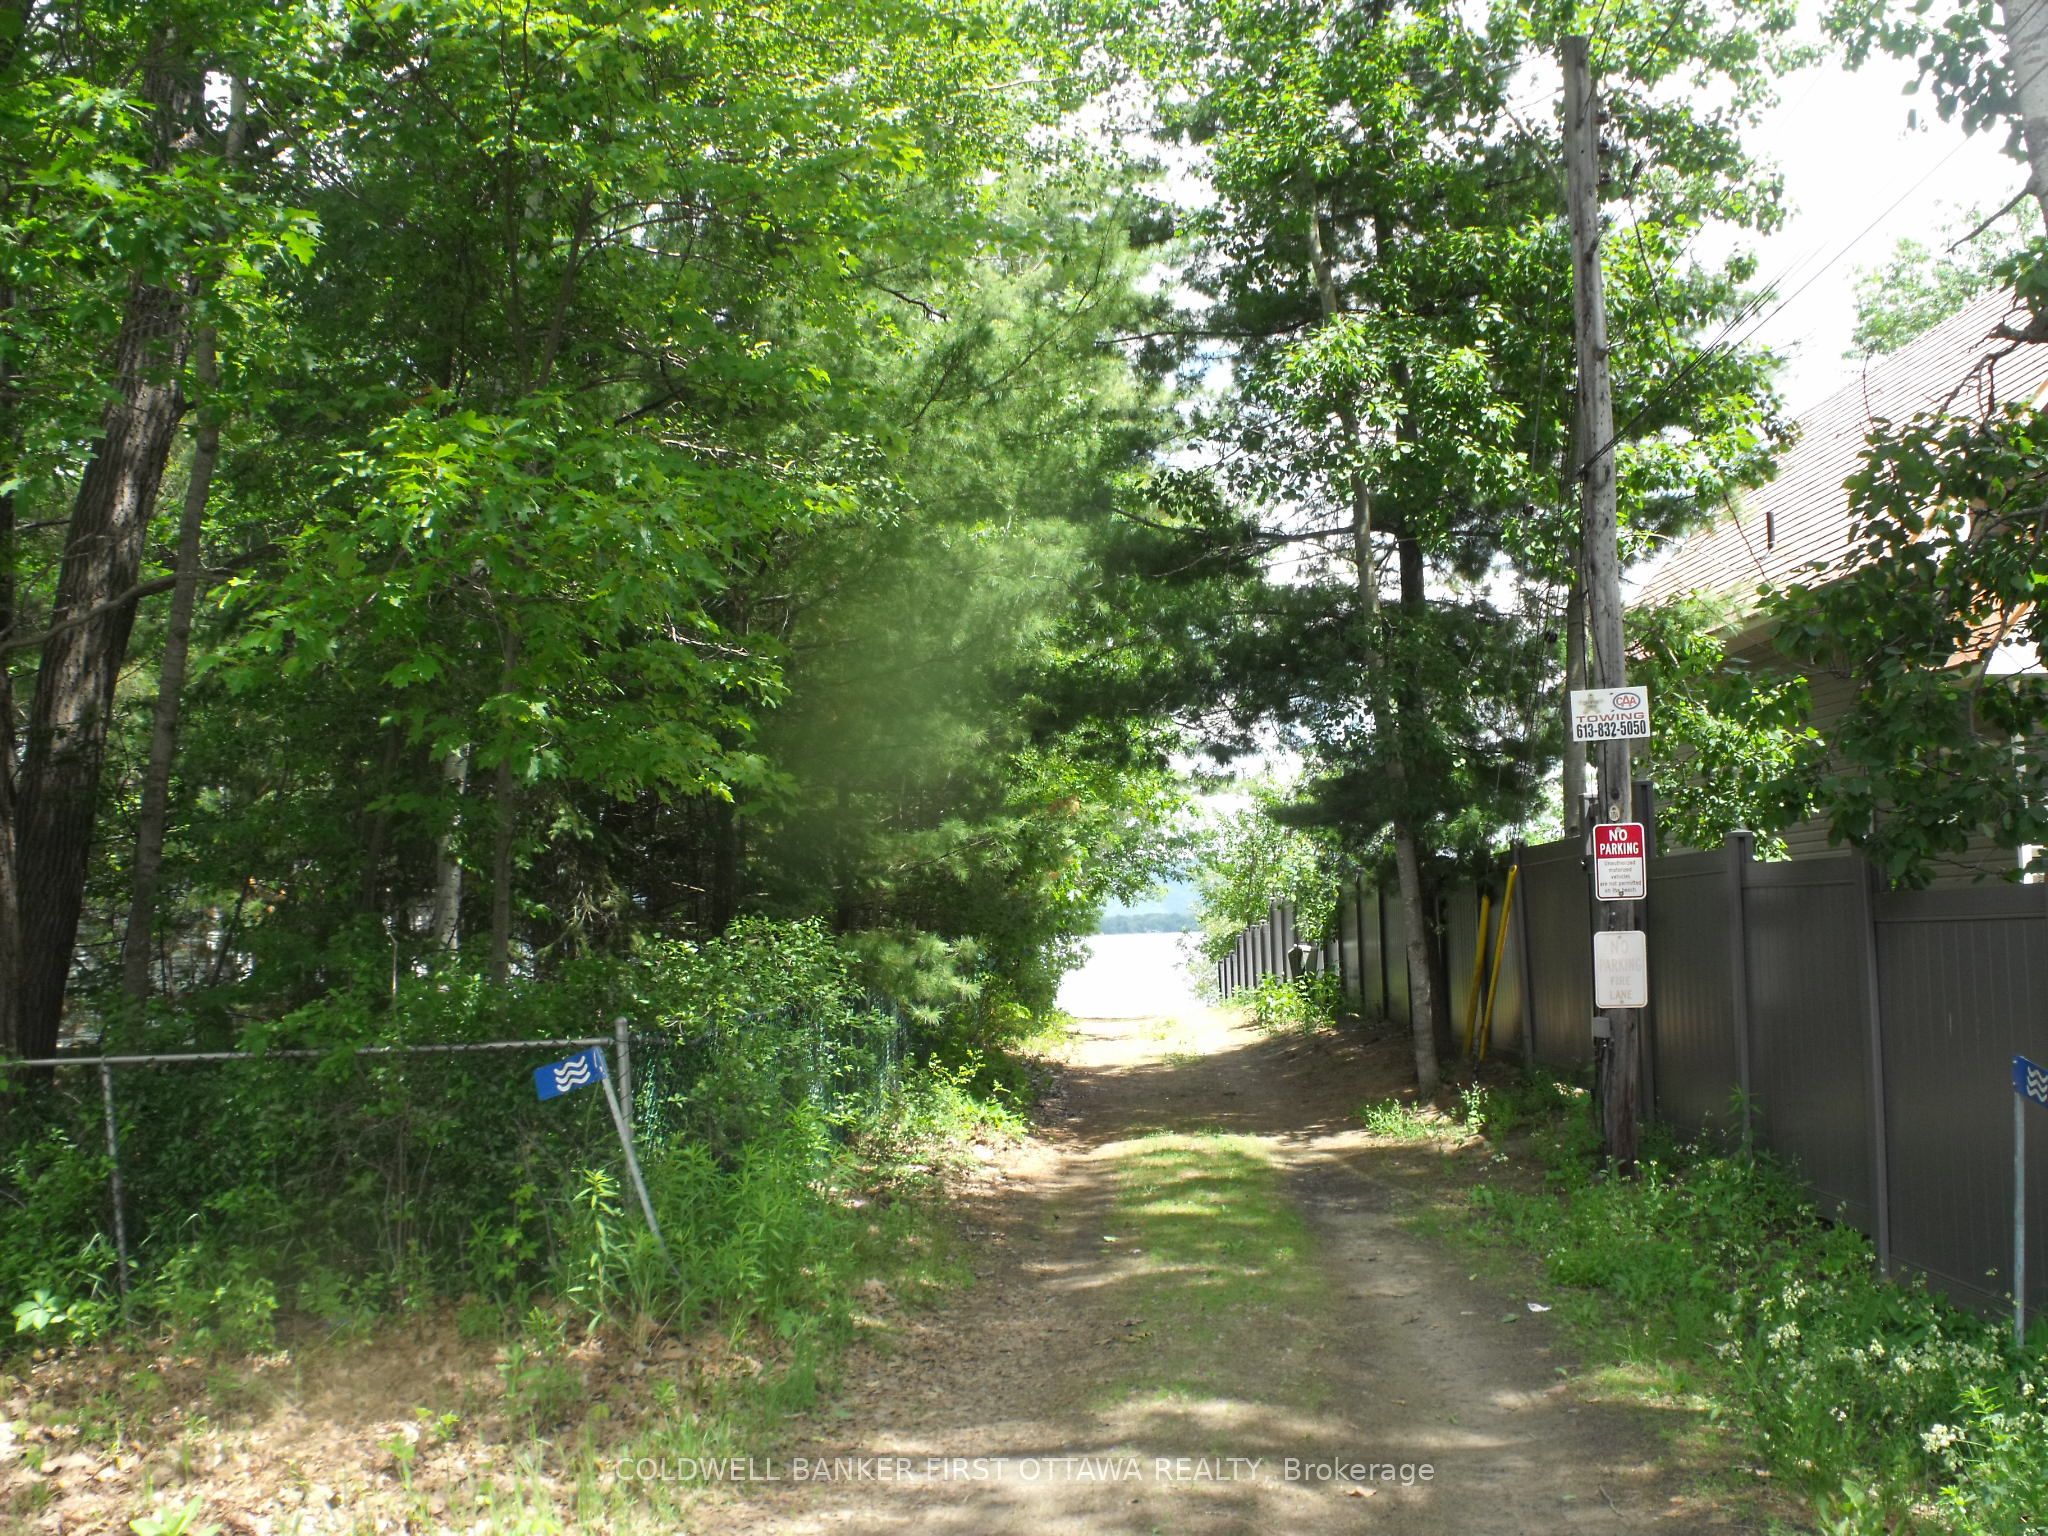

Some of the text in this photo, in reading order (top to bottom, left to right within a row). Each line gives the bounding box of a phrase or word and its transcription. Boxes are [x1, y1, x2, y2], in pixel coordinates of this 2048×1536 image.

[1616, 695, 1637, 707] CAA
[1576, 712, 1645, 723] TOWING
[1577, 720, 1647, 738] 613-832-5050
[1609, 829, 1627, 841] NO
[1600, 842, 1639, 855] PARKING
[1610, 940, 1628, 954] NO
[1599, 958, 1641, 973] PARKING
[1610, 976, 1631, 986] FIRE
[1609, 990, 1632, 1000] LANE
